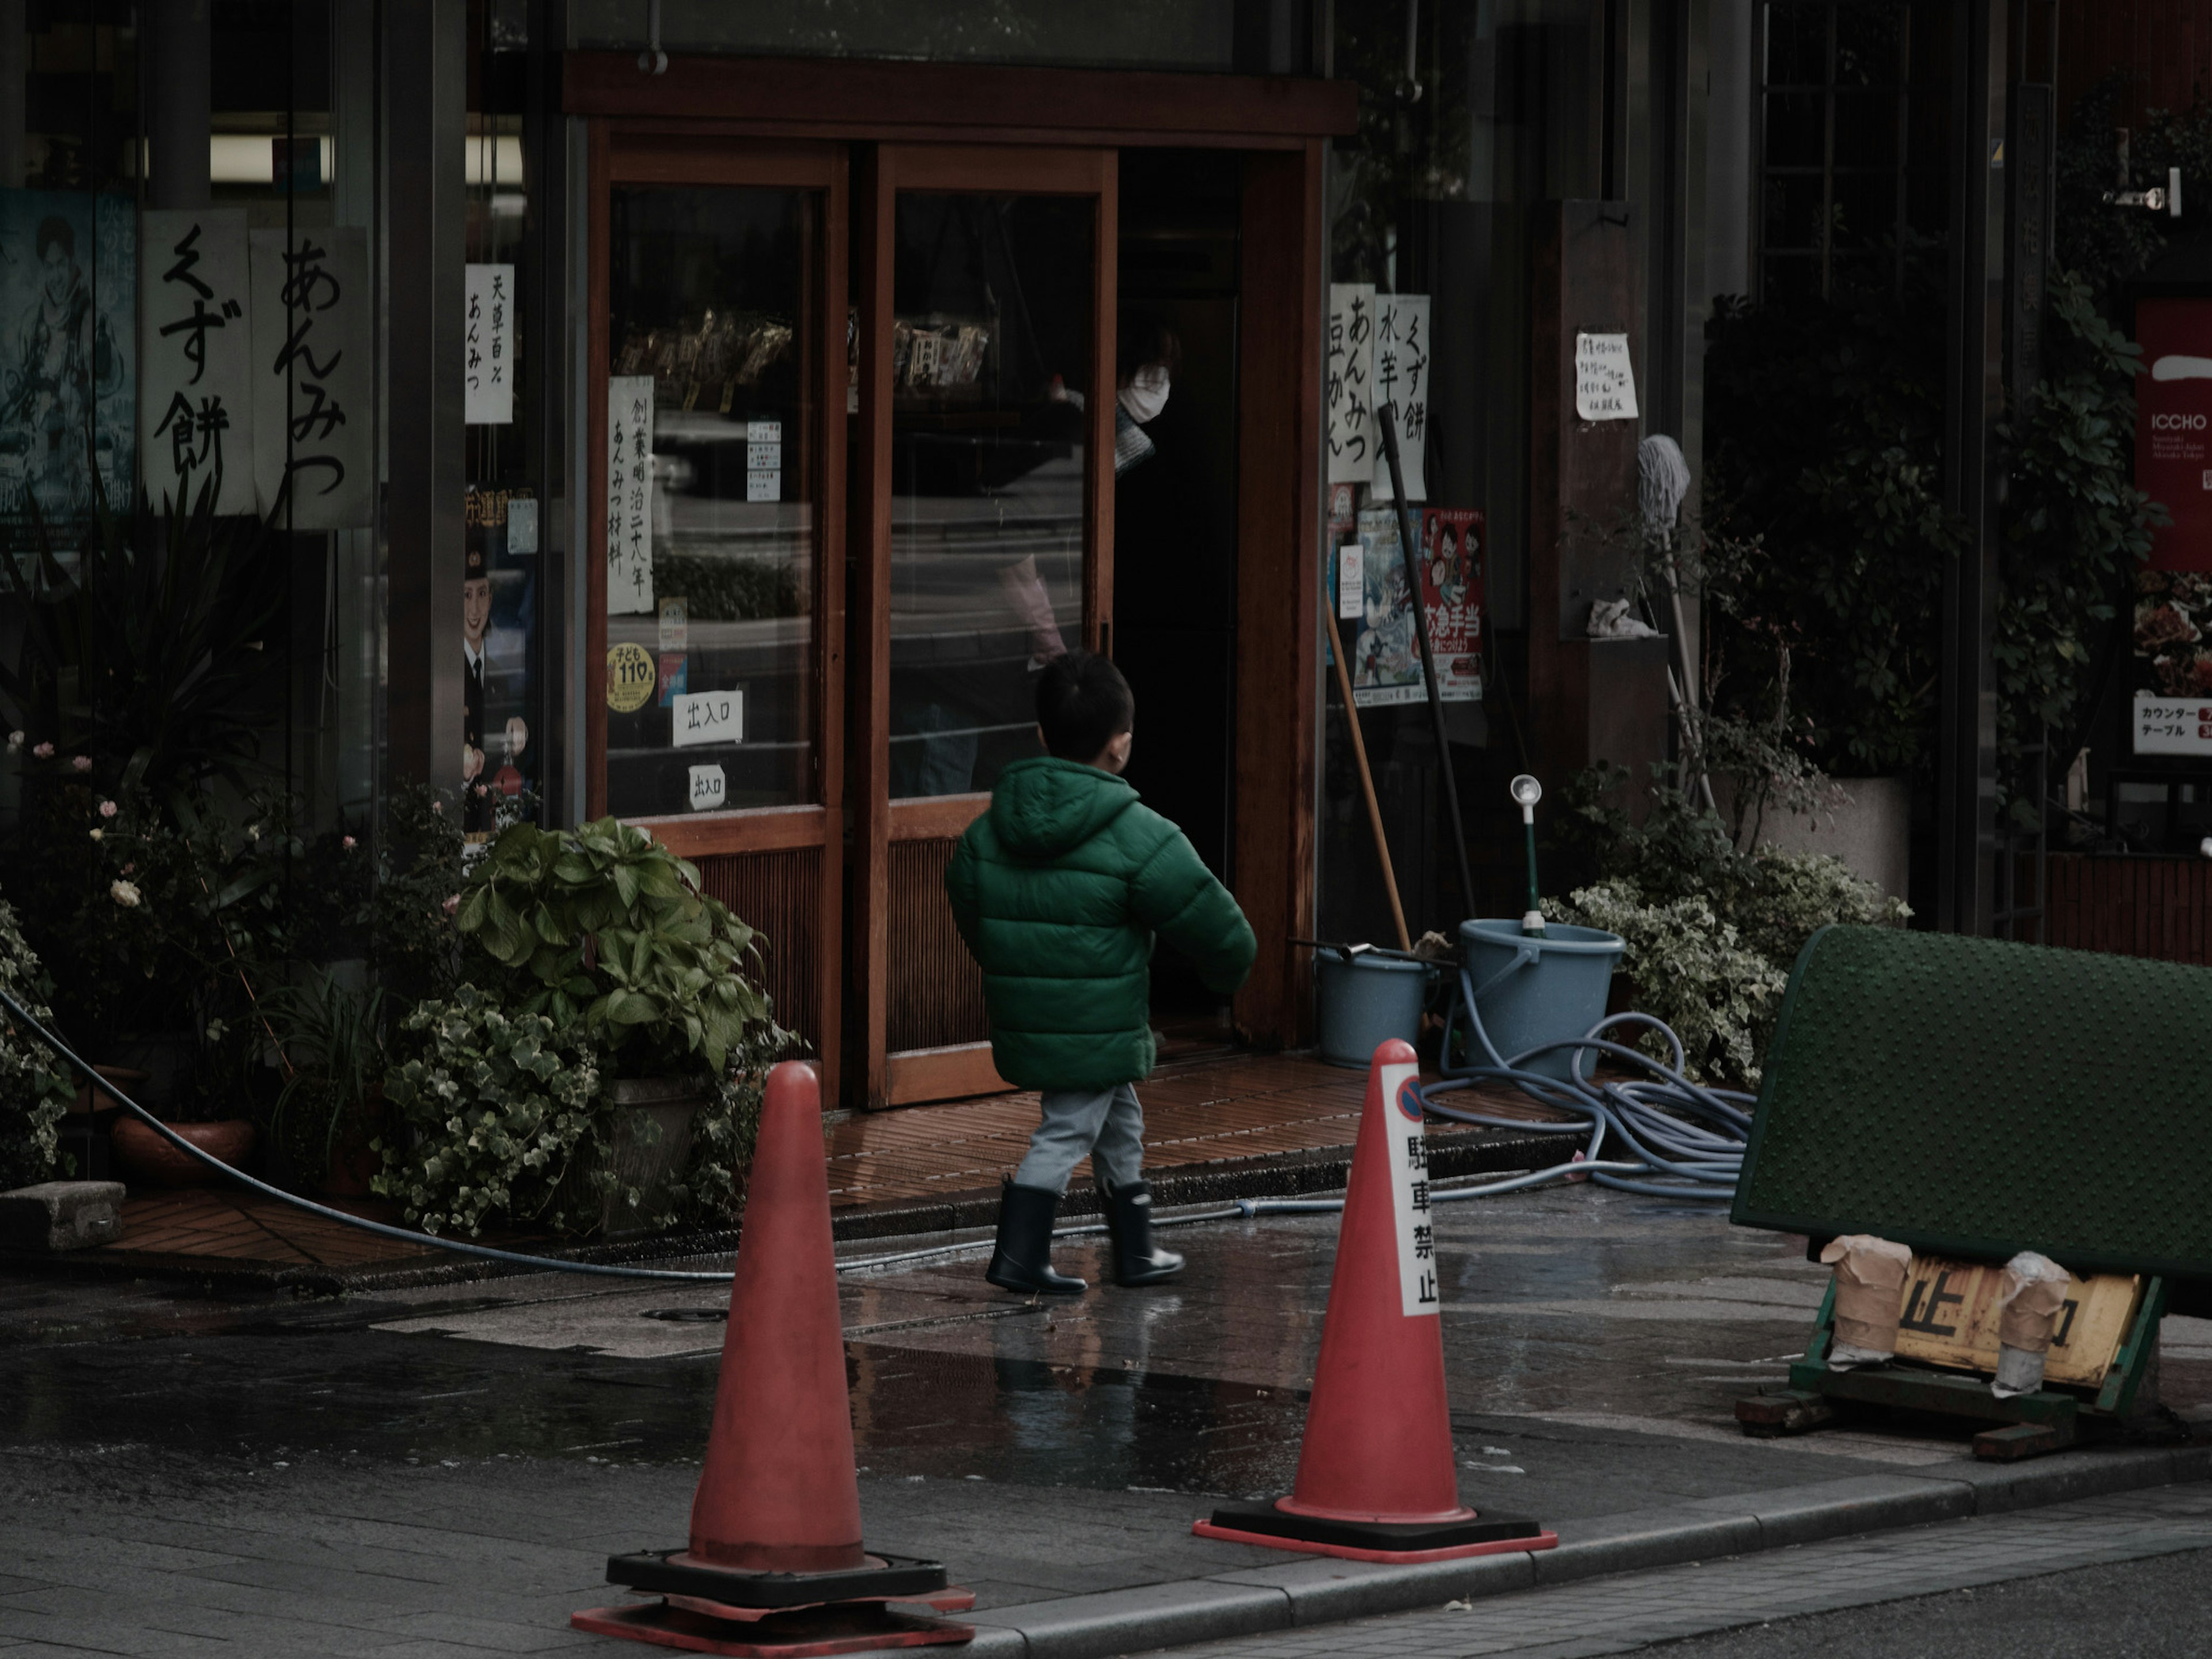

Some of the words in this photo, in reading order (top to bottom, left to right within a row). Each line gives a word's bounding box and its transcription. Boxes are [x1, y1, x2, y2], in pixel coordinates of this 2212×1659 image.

[154, 223, 242, 476] くず餅
[274, 237, 346, 495] あんみつ
[467, 291, 482, 391] あんみつ
[1328, 313, 1345, 456] 豆かん
[1344, 295, 1370, 463] あんみつ
[1376, 304, 1400, 460] 水羊
[1403, 314, 1427, 441] くず餅
[2152, 414, 2207, 430] ICCHO
[608, 419, 624, 576] あんみつ材料
[630, 398, 647, 597] 創業明治二十八年
[616, 647, 640, 662] 子ども
[688, 702, 730, 730] 出入口
[2142, 707, 2196, 719] カウンター
[694, 774, 721, 797] 出入口
[2142, 724, 2186, 736] テーブル
[1407, 1135, 1437, 1304] 駐車禁止
